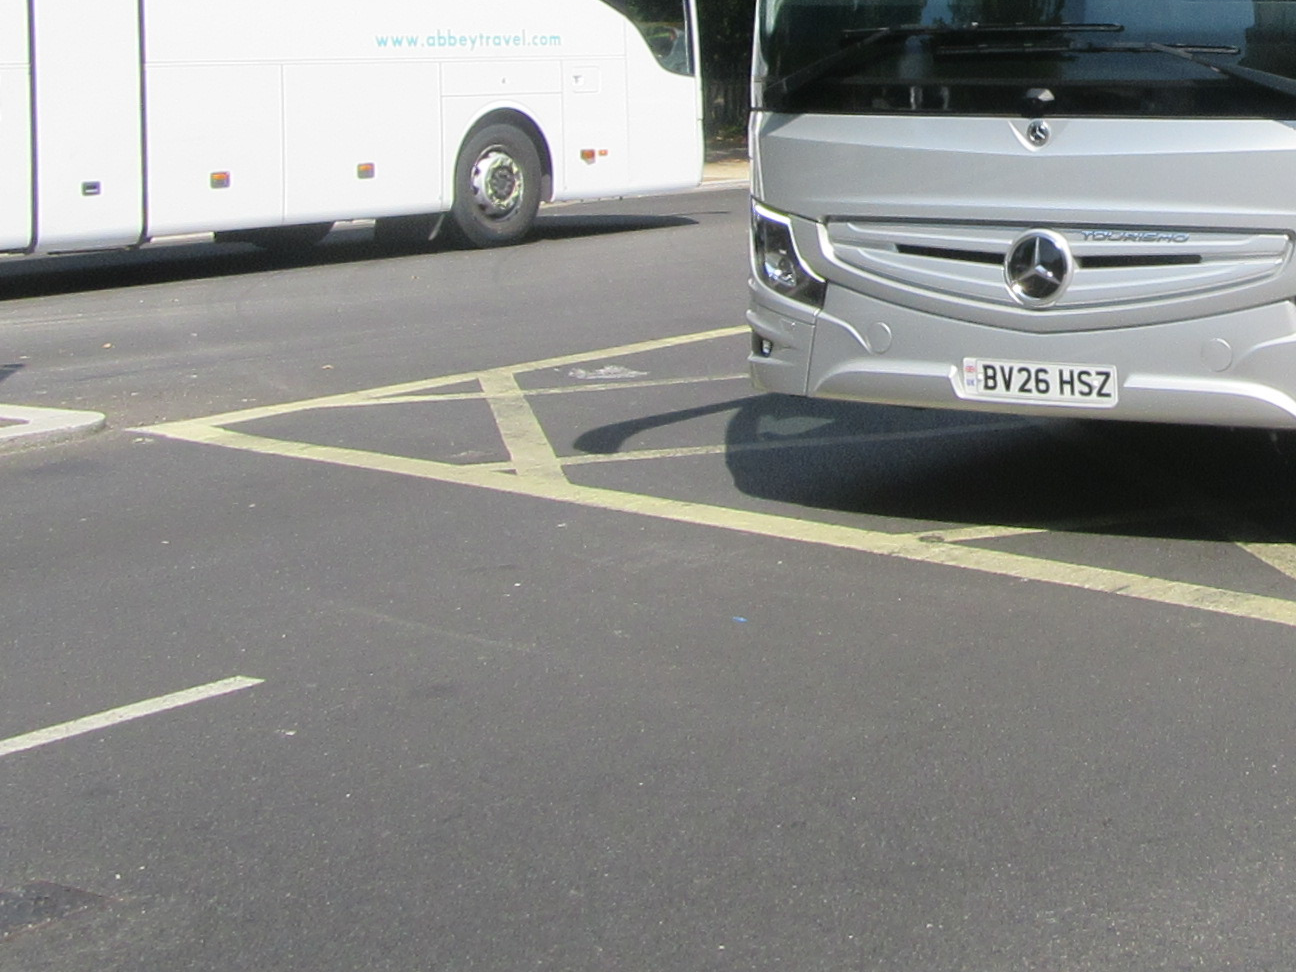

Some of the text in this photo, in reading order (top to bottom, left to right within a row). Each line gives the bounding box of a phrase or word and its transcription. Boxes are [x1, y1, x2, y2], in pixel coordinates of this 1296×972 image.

[375, 29, 562, 51] www.abbeytravel.com
[1080, 230, 1190, 243] TOURISMO
[982, 364, 1112, 398] BV26 HSZ
